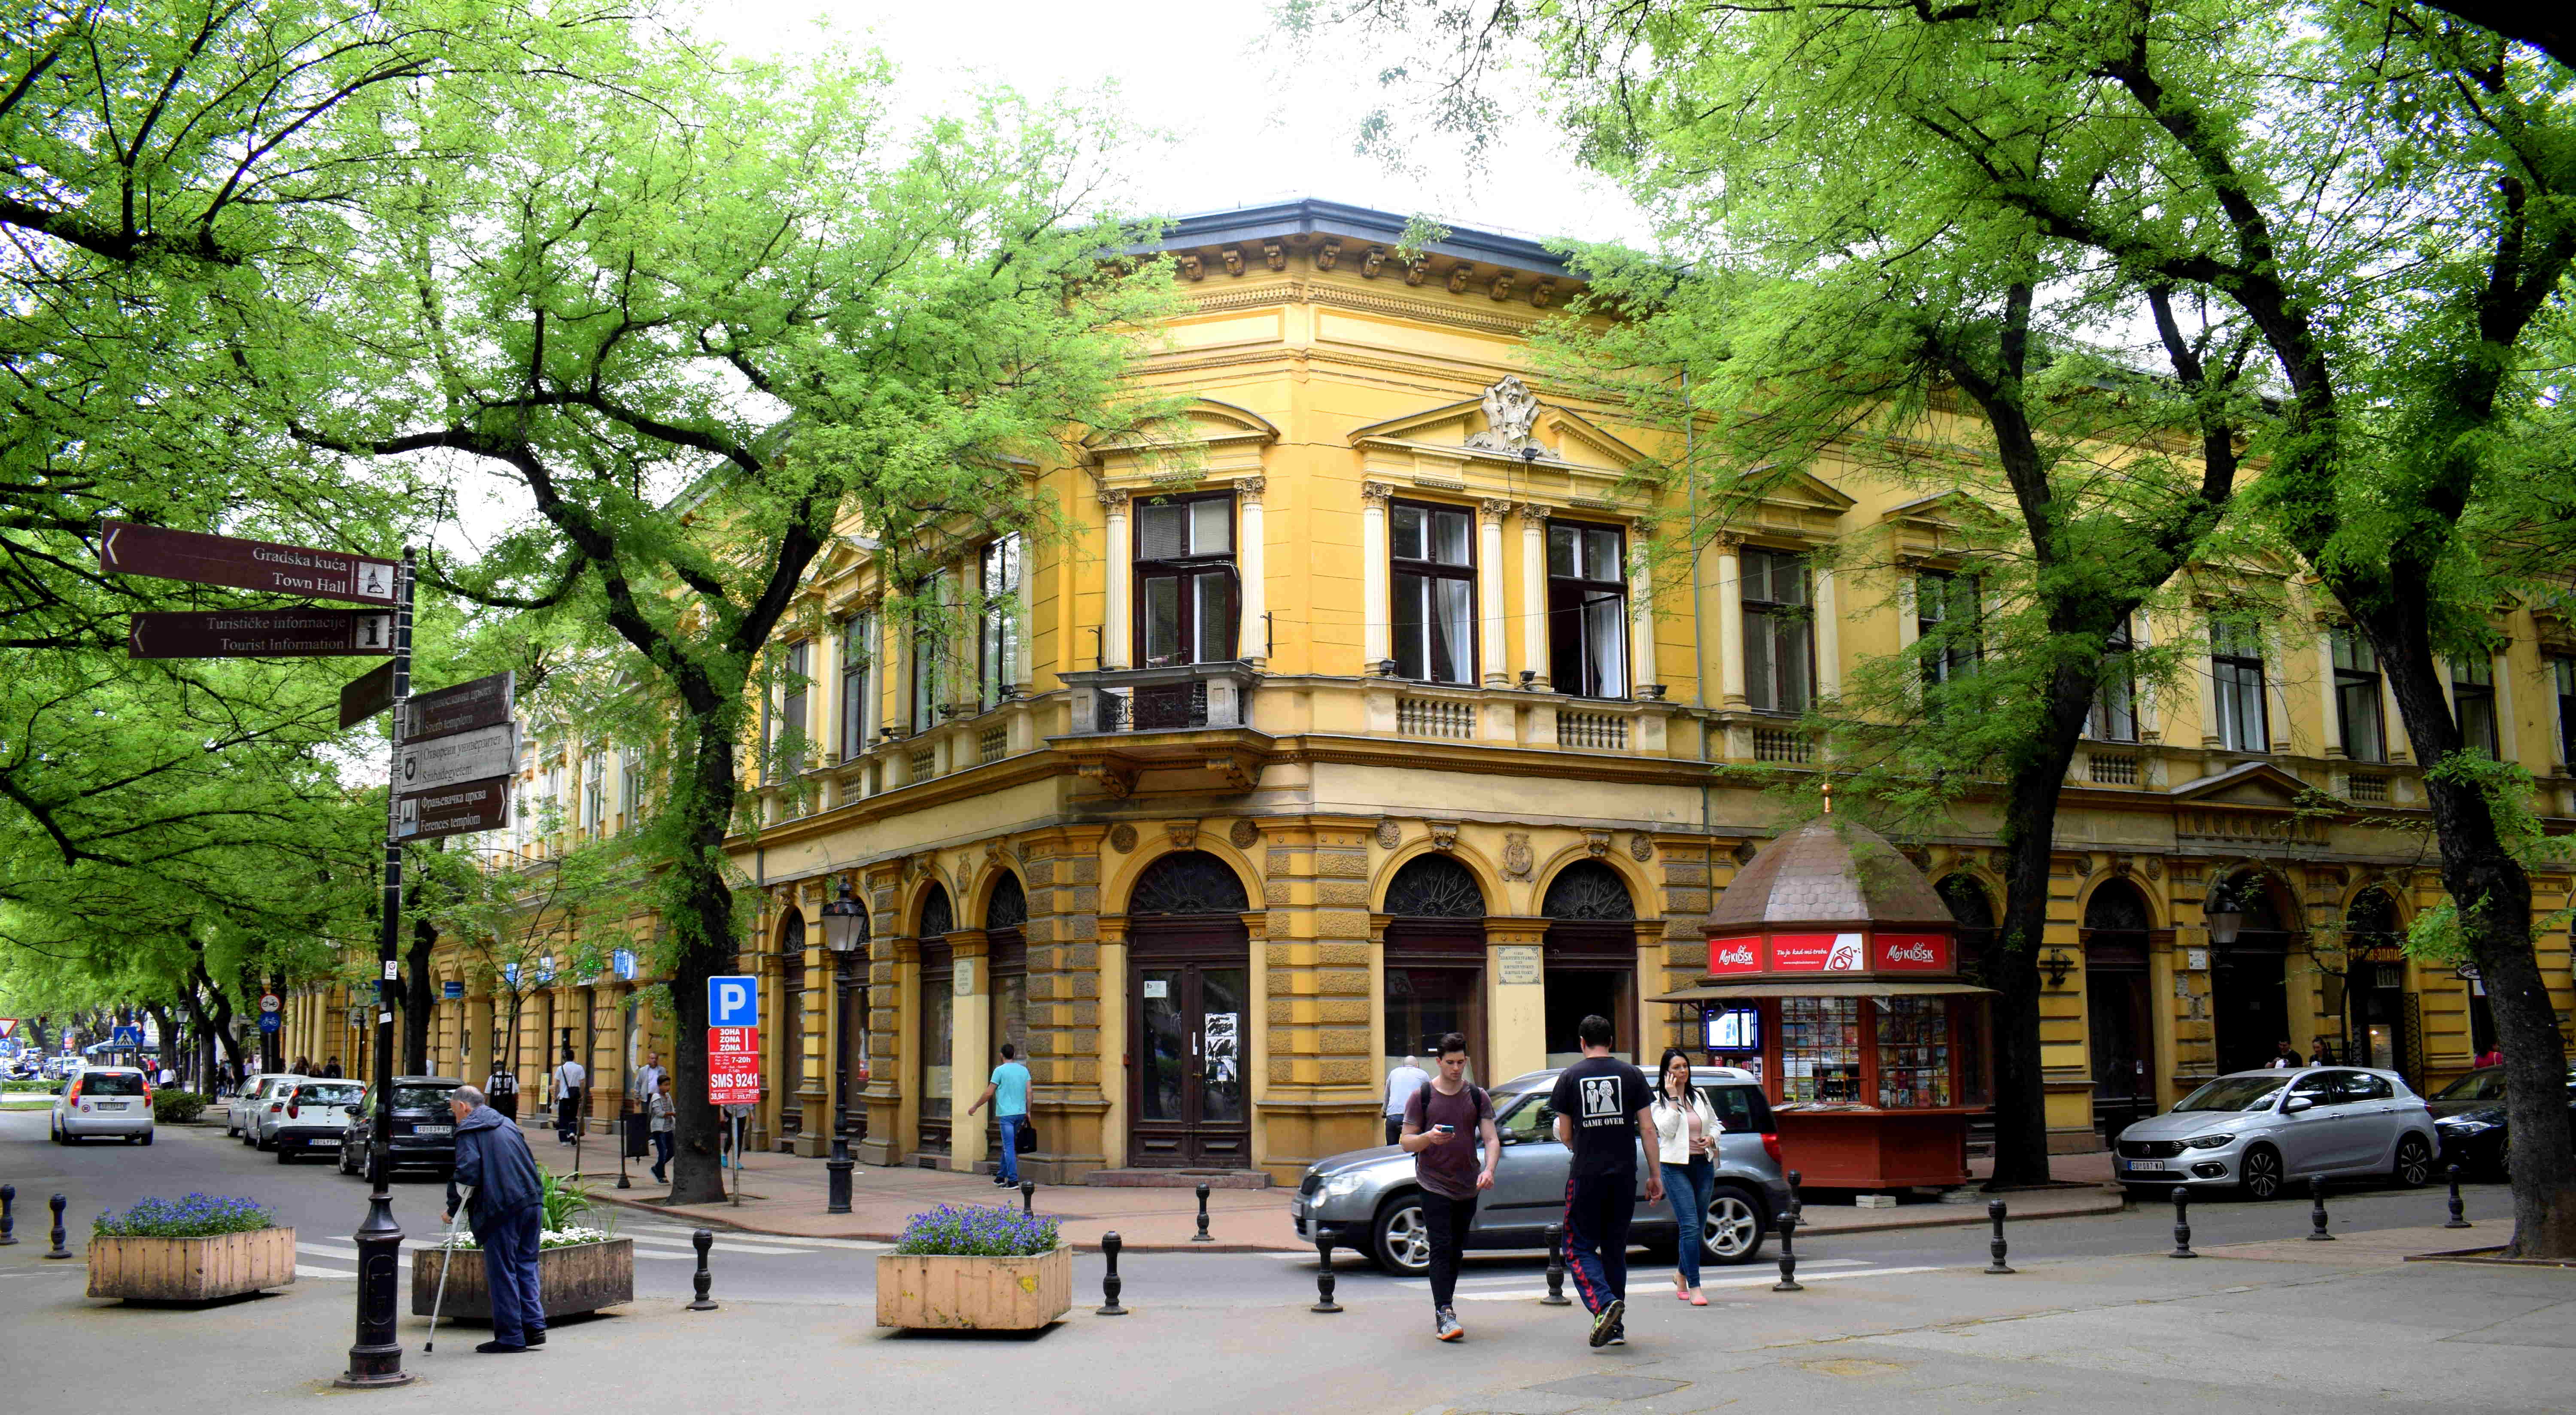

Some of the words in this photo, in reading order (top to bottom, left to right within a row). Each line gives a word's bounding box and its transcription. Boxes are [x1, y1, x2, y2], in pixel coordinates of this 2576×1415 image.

[253, 547, 310, 566] Gradska
[315, 556, 347, 571] kuća
[273, 572, 313, 589] Town
[316, 578, 346, 593] Hall
[206, 616, 270, 630] Turističke
[274, 616, 346, 630] informacije
[220, 638, 265, 650] Tourist
[270, 638, 344, 650] Information
[422, 793, 463, 811] Фрањевачка
[465, 789, 486, 805] црква
[420, 817, 449, 832] Ferences
[450, 813, 480, 830] templom
[1719, 949, 1731, 965] Moj
[1731, 951, 1753, 963] KIOSK
[1886, 944, 1903, 962] Moj
[1904, 949, 1933, 960] KIOSK
[720, 984, 746, 1020] P
[711, 1073, 734, 1088] SMS
[735, 1073, 758, 1087] 9241
[1583, 1119, 1603, 1128] GAME
